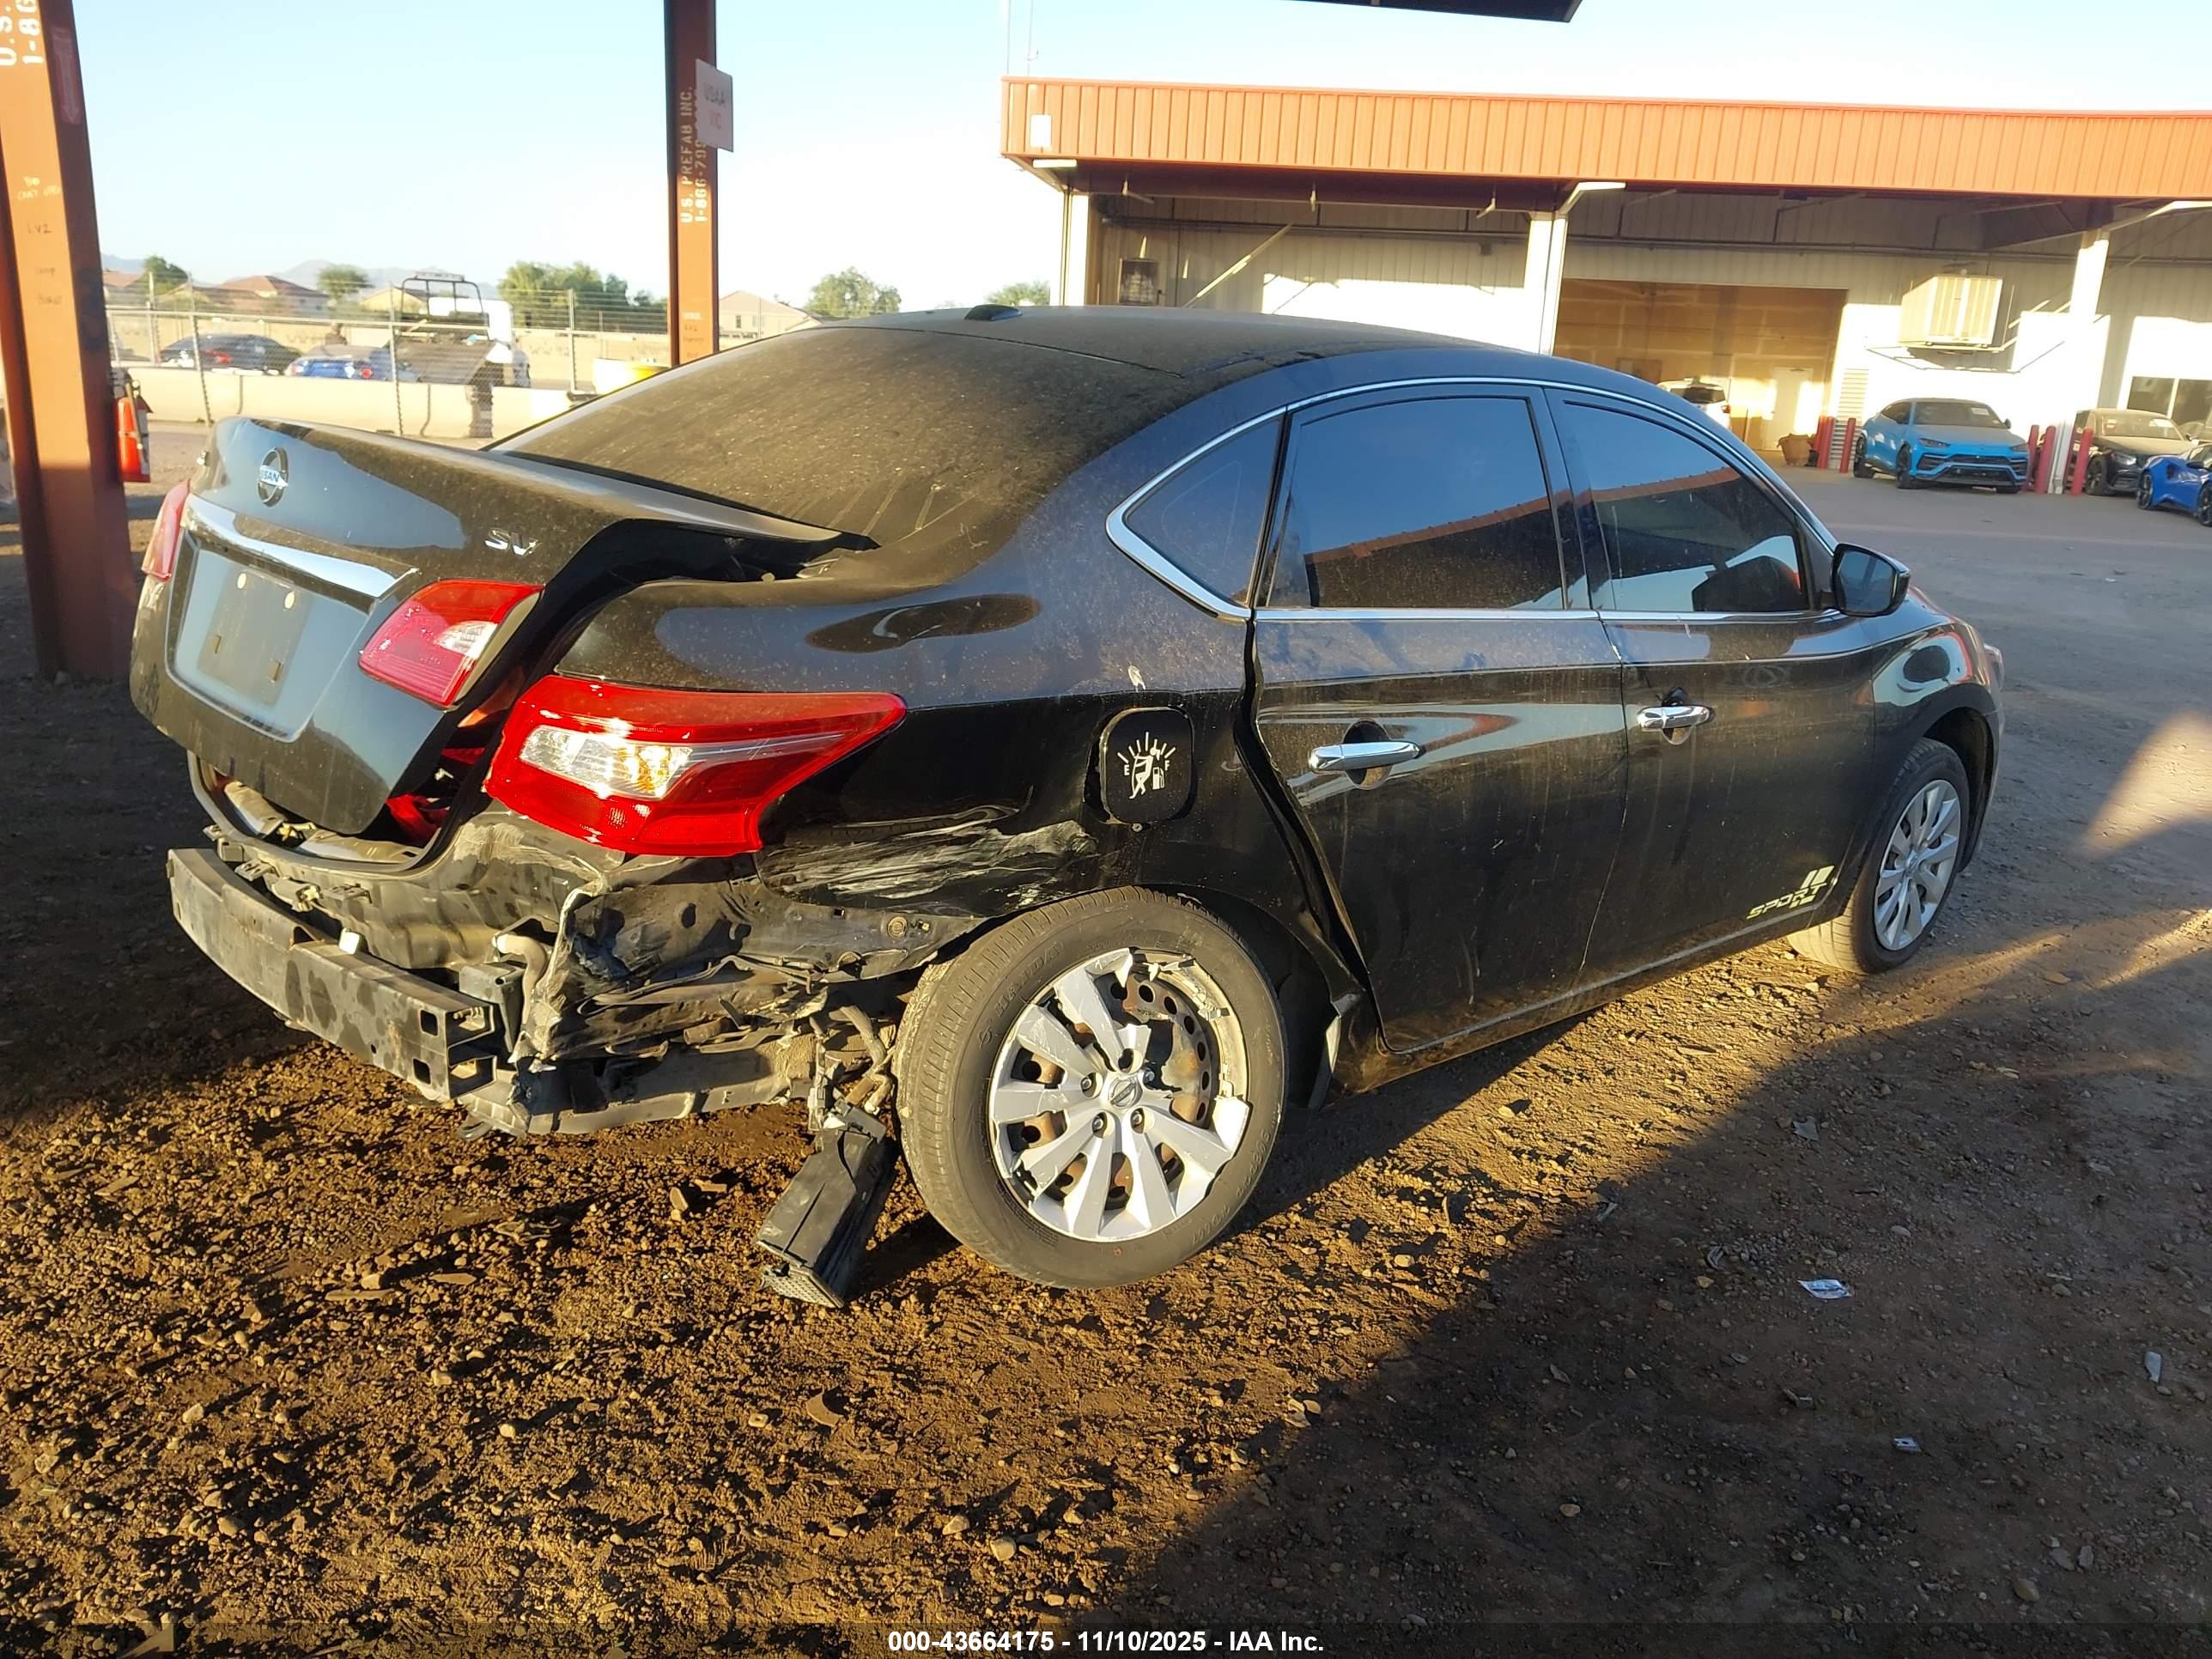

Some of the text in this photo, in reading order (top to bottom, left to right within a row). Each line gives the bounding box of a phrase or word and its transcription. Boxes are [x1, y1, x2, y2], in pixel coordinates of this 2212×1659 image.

[679, 86, 694, 224] U.S. PREFAB INC.
[483, 526, 543, 557] SV
[1123, 763, 1130, 776] E
[1164, 760, 1170, 772] F
[1746, 882, 1827, 921] SPORT
